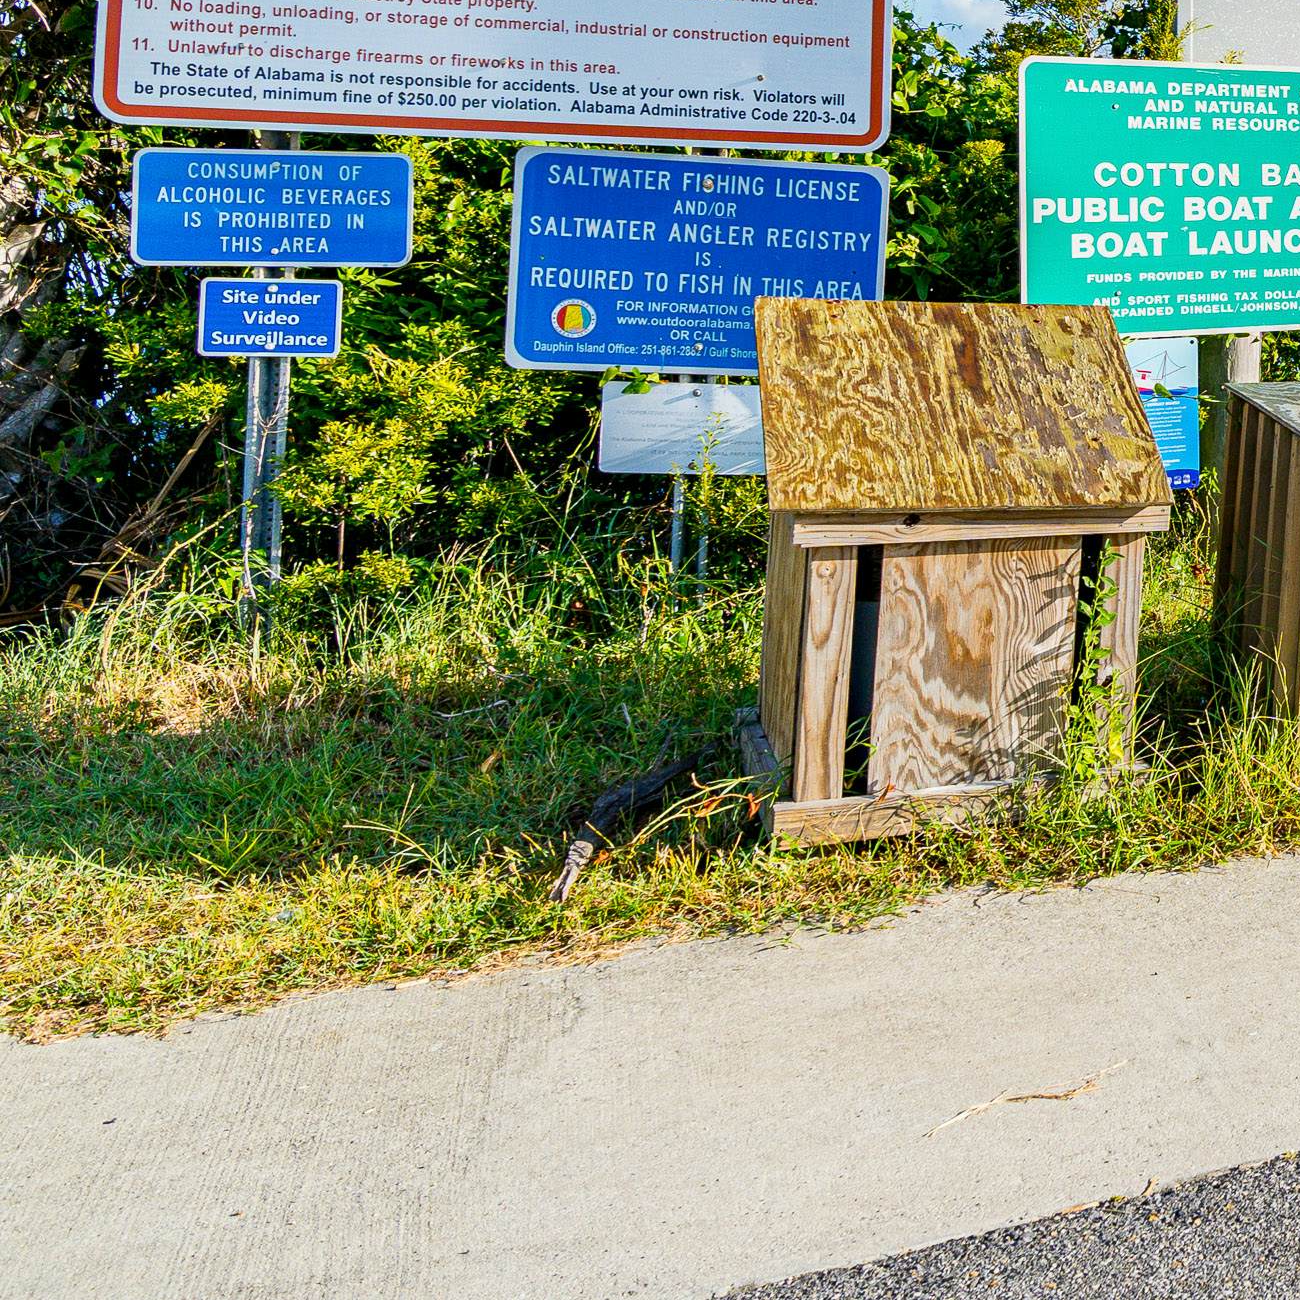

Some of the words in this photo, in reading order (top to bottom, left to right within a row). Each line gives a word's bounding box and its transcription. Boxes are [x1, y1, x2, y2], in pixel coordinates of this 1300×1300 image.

[1064, 78, 1157, 94] ALABAMA
[1167, 82, 1290, 98] DEPARTMENT
[134, 80, 154, 94] be
[159, 85, 256, 100] prosecuted,
[262, 86, 337, 102] minimum
[342, 89, 372, 103] fine
[377, 91, 393, 104] of
[397, 91, 456, 107] $250.00
[461, 98, 487, 110] per
[491, 96, 560, 112] violation.
[569, 99, 635, 115] Alabama
[639, 102, 747, 120] Administrative
[751, 107, 788, 121] Code
[792, 109, 856, 124] 220-3-.04
[1144, 98, 1184, 112] AND
[1195, 100, 1277, 114] NATURAL
[1127, 115, 1201, 130] MARINE
[188, 162, 323, 181] CONSUMPTION
[339, 165, 362, 181] OF
[1094, 162, 1239, 187] COTTON
[547, 164, 670, 190] SALTWATER
[775, 178, 860, 201] LICENSE
[157, 187, 265, 204] ALCOHOLIC
[282, 189, 391, 206] BEVERAGES
[673, 199, 736, 217] AND/OR
[1033, 196, 1164, 223] PUBLIC
[1183, 195, 1272, 221] BOAT
[183, 211, 201, 228] IS
[218, 212, 331, 229] PROHIBITED
[347, 214, 364, 230] IN
[528, 215, 656, 241] SALTWATER
[667, 222, 754, 245] ANGLER
[766, 228, 871, 252] REGISTRY
[220, 236, 262, 253] THIS
[280, 237, 329, 253] AREA
[1071, 231, 1168, 258] BOAT
[695, 251, 711, 266] IS
[530, 266, 633, 291] REQUIRED
[644, 272, 668, 292] TO
[678, 273, 723, 295] FISH
[733, 276, 752, 296] IN
[762, 277, 804, 298] THIS
[813, 280, 863, 300] AREA
[1087, 272, 1131, 283] FUNDS
[1139, 271, 1203, 280] PROVIDED
[1210, 270, 1226, 279] BY
[1232, 269, 1256, 278] THE
[222, 289, 259, 304] Site
[265, 291, 321, 305] under
[1093, 297, 1121, 306] AND
[1127, 294, 1169, 305] SPORT
[1177, 293, 1228, 303] FISHING
[1234, 291, 1257, 300] TAX
[616, 300, 644, 311] FOR
[647, 301, 737, 315] INFORMATION
[742, 306, 755, 316] G
[1111, 307, 1174, 318] XPANDED
[243, 310, 300, 325] Video
[211, 331, 328, 347] Surveillance
[670, 329, 689, 340] OR
[693, 330, 727, 341] CALL
[533, 340, 573, 353] Dauphin
[576, 342, 605, 353] Island
[607, 342, 638, 354] Office:
[709, 346, 729, 357] Gulf
